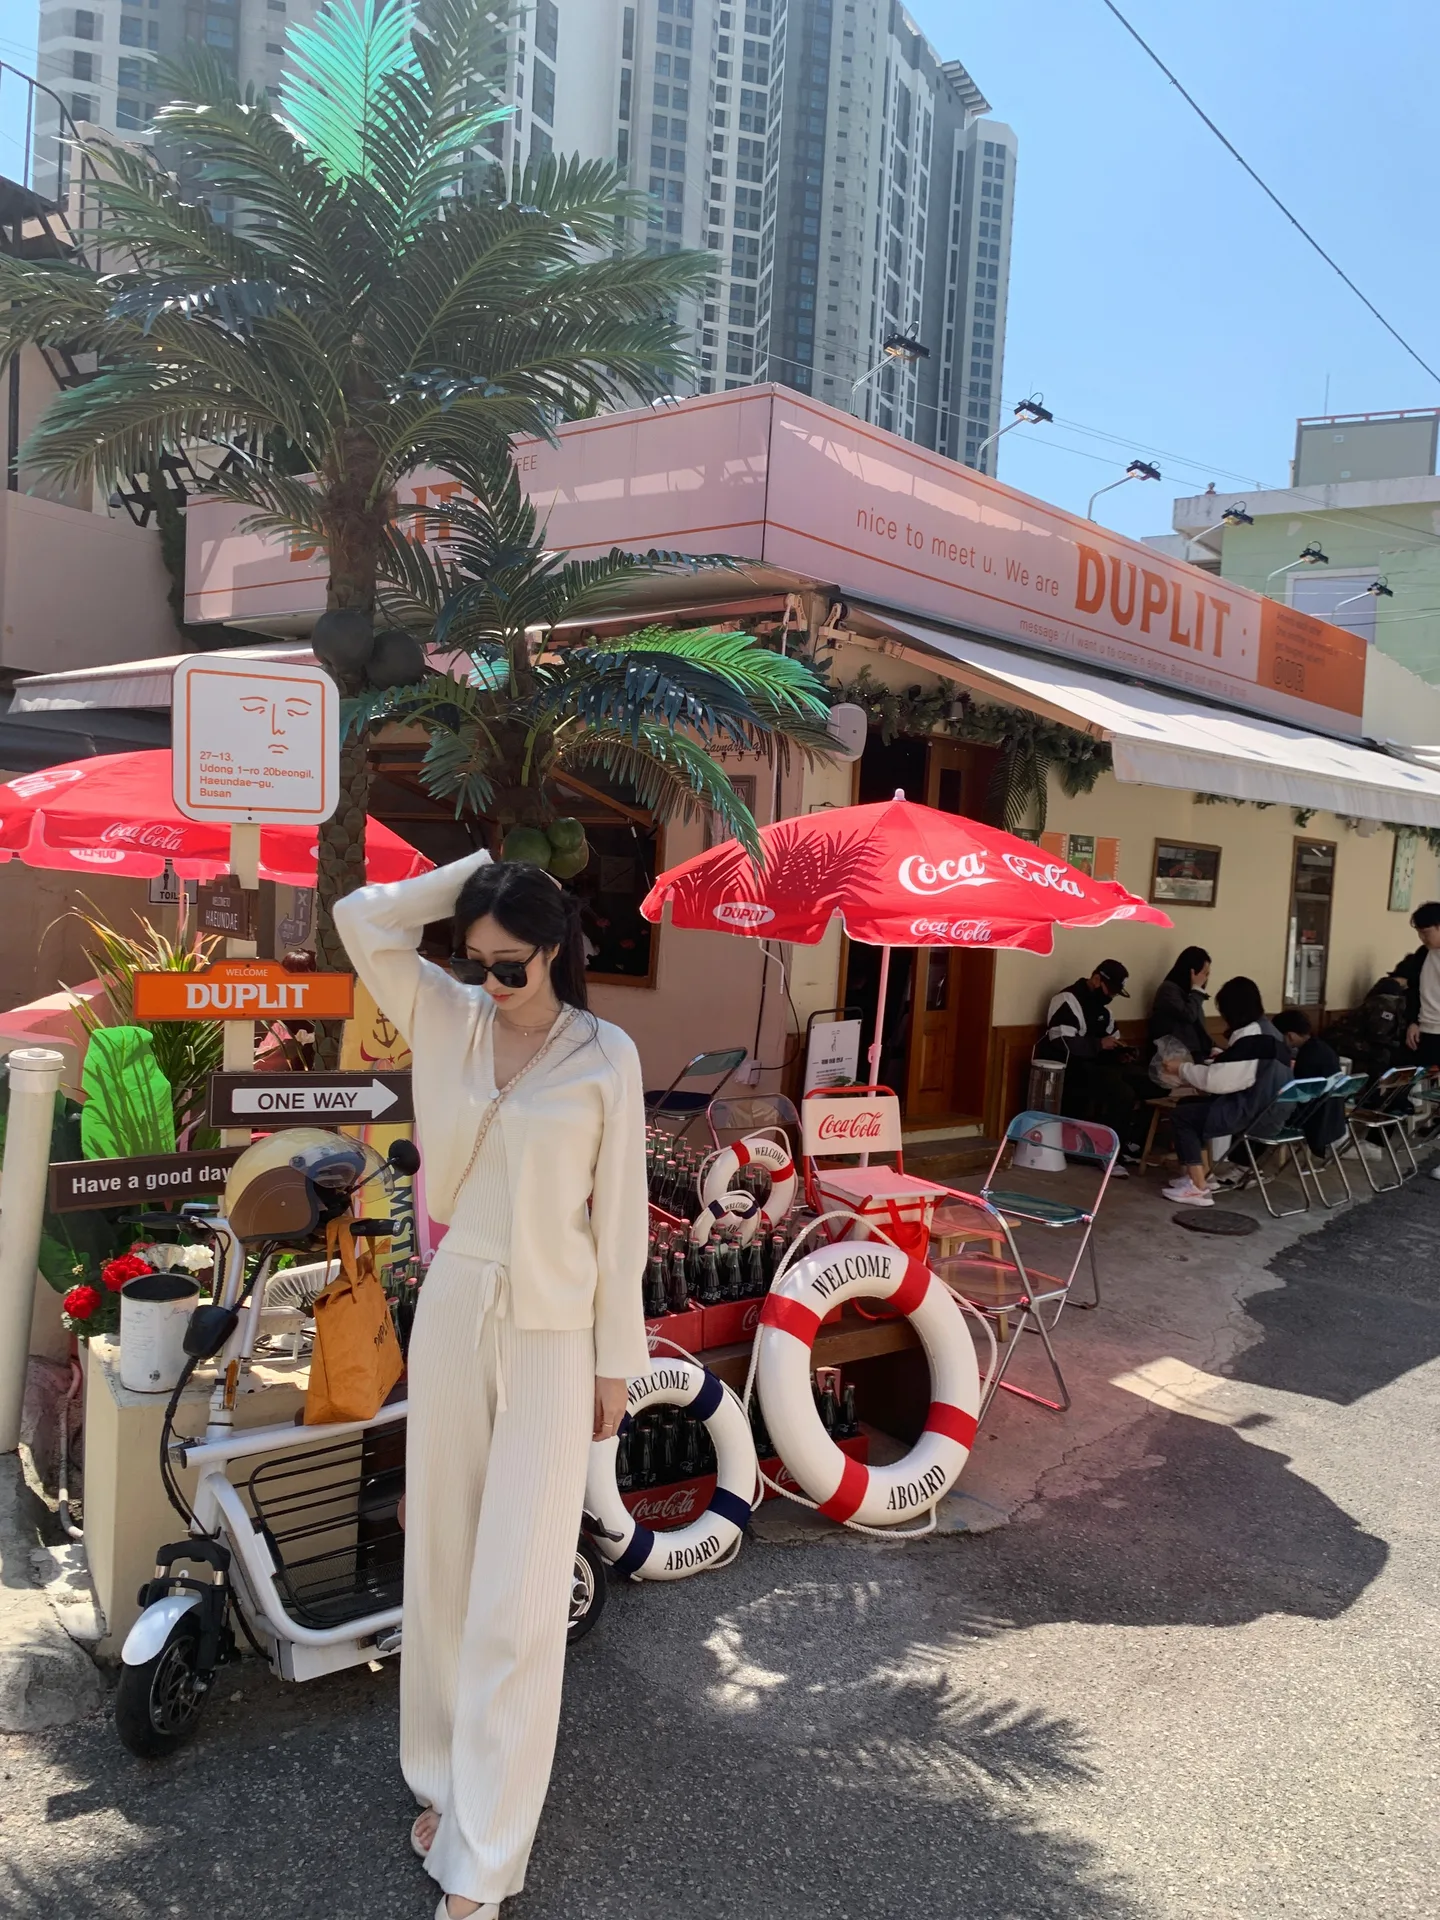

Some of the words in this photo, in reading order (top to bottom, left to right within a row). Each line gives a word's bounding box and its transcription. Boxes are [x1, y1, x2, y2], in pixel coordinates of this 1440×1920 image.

[856, 507, 898, 541] nice
[906, 523, 924, 550] to
[931, 536, 976, 569] meet
[983, 555, 997, 576] u.
[1005, 557, 1029, 586] We
[1035, 574, 1060, 597] are
[1074, 541, 1231, 658] DUPLIT
[1019, 619, 1059, 642] message
[199, 763, 234, 774] Udong
[238, 765, 260, 776] 1-ro
[199, 787, 232, 798] Busan
[100, 821, 188, 851] Coca-Cola
[205, 909, 238, 931] HAEUNDAE
[295, 886, 309, 938] XIT
[721, 906, 769, 922] DUPLIT
[910, 917, 993, 942] Coca-Cola
[225, 968, 269, 977] WELCOME
[184, 983, 310, 1009] DUPLIT
[257, 1092, 305, 1110] ONE
[313, 1092, 358, 1109] WAY
[818, 1111, 884, 1140] Coca-Cola
[754, 1146, 787, 1167] WELCOME
[72, 1176, 121, 1194] Have
[127, 1175, 139, 1189] a
[145, 1167, 192, 1190] good
[199, 1165, 232, 1183] day
[811, 1254, 892, 1299] WELCOME
[886, 1464, 947, 1511] ABOARD
[631, 1487, 700, 1521] Coca-Cola
[664, 1535, 721, 1571] ABOARD
